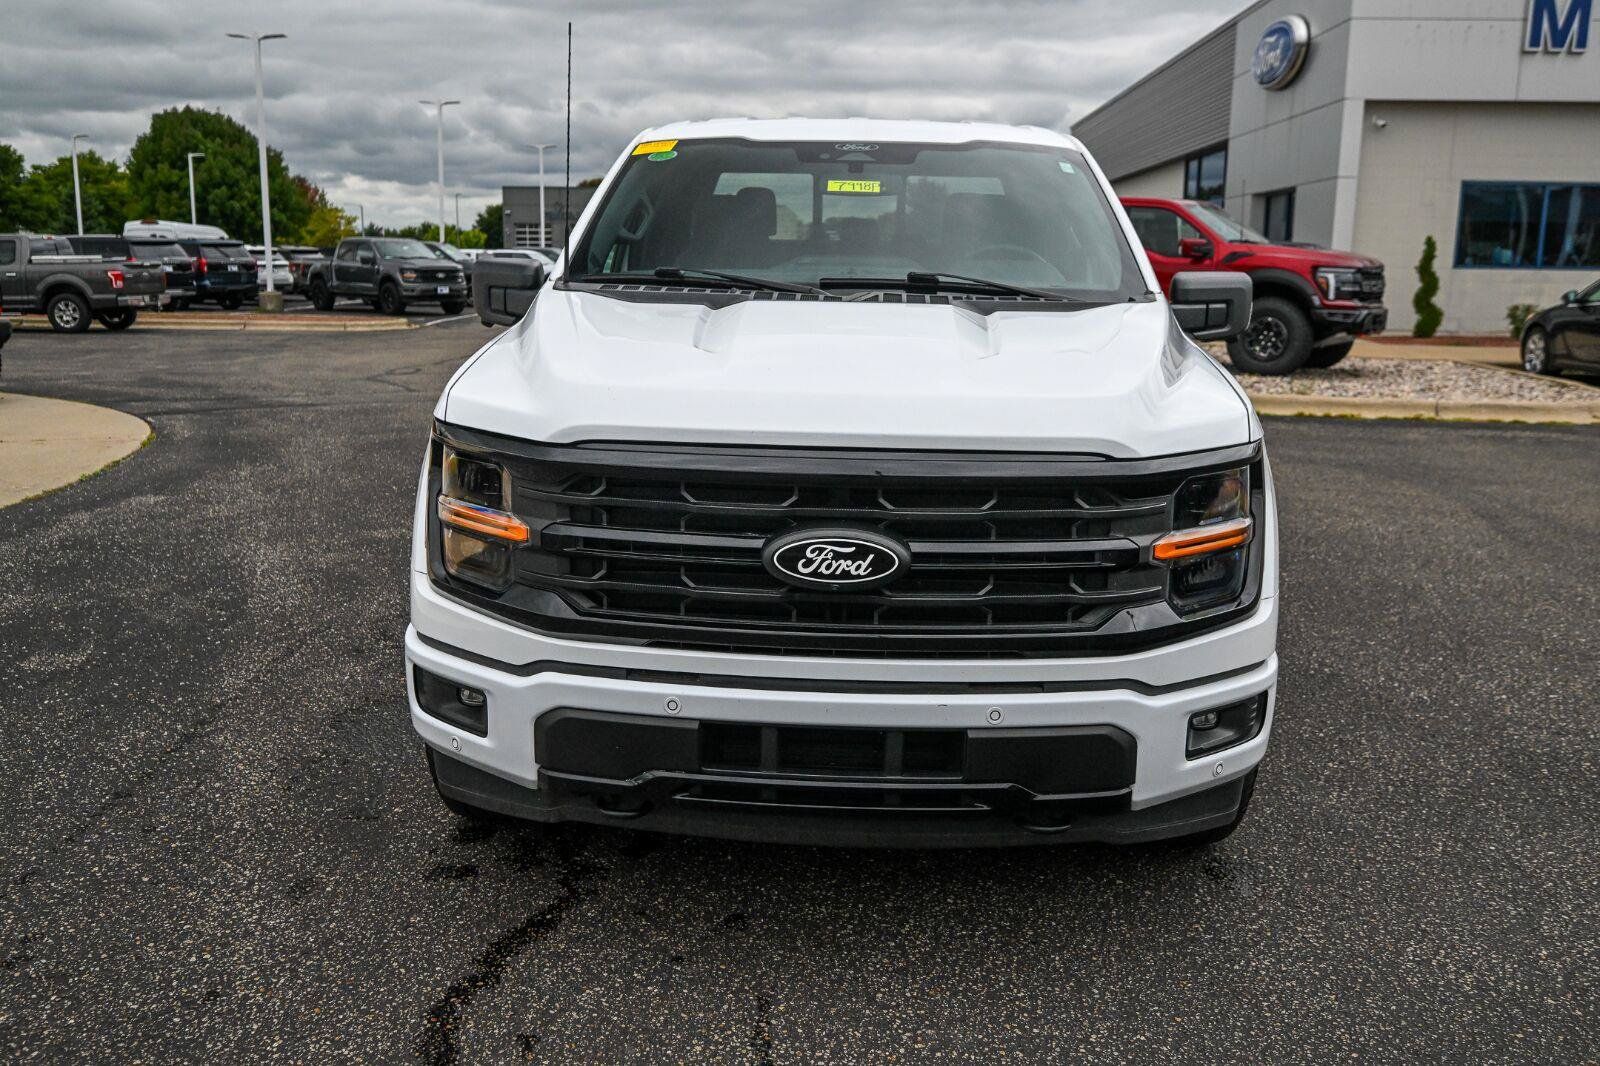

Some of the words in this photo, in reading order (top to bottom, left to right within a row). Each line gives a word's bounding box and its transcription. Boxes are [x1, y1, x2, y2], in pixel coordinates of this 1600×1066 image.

[1525, 0, 1592, 52] M
[1256, 34, 1286, 75] Ford
[797, 544, 875, 576] Ford
